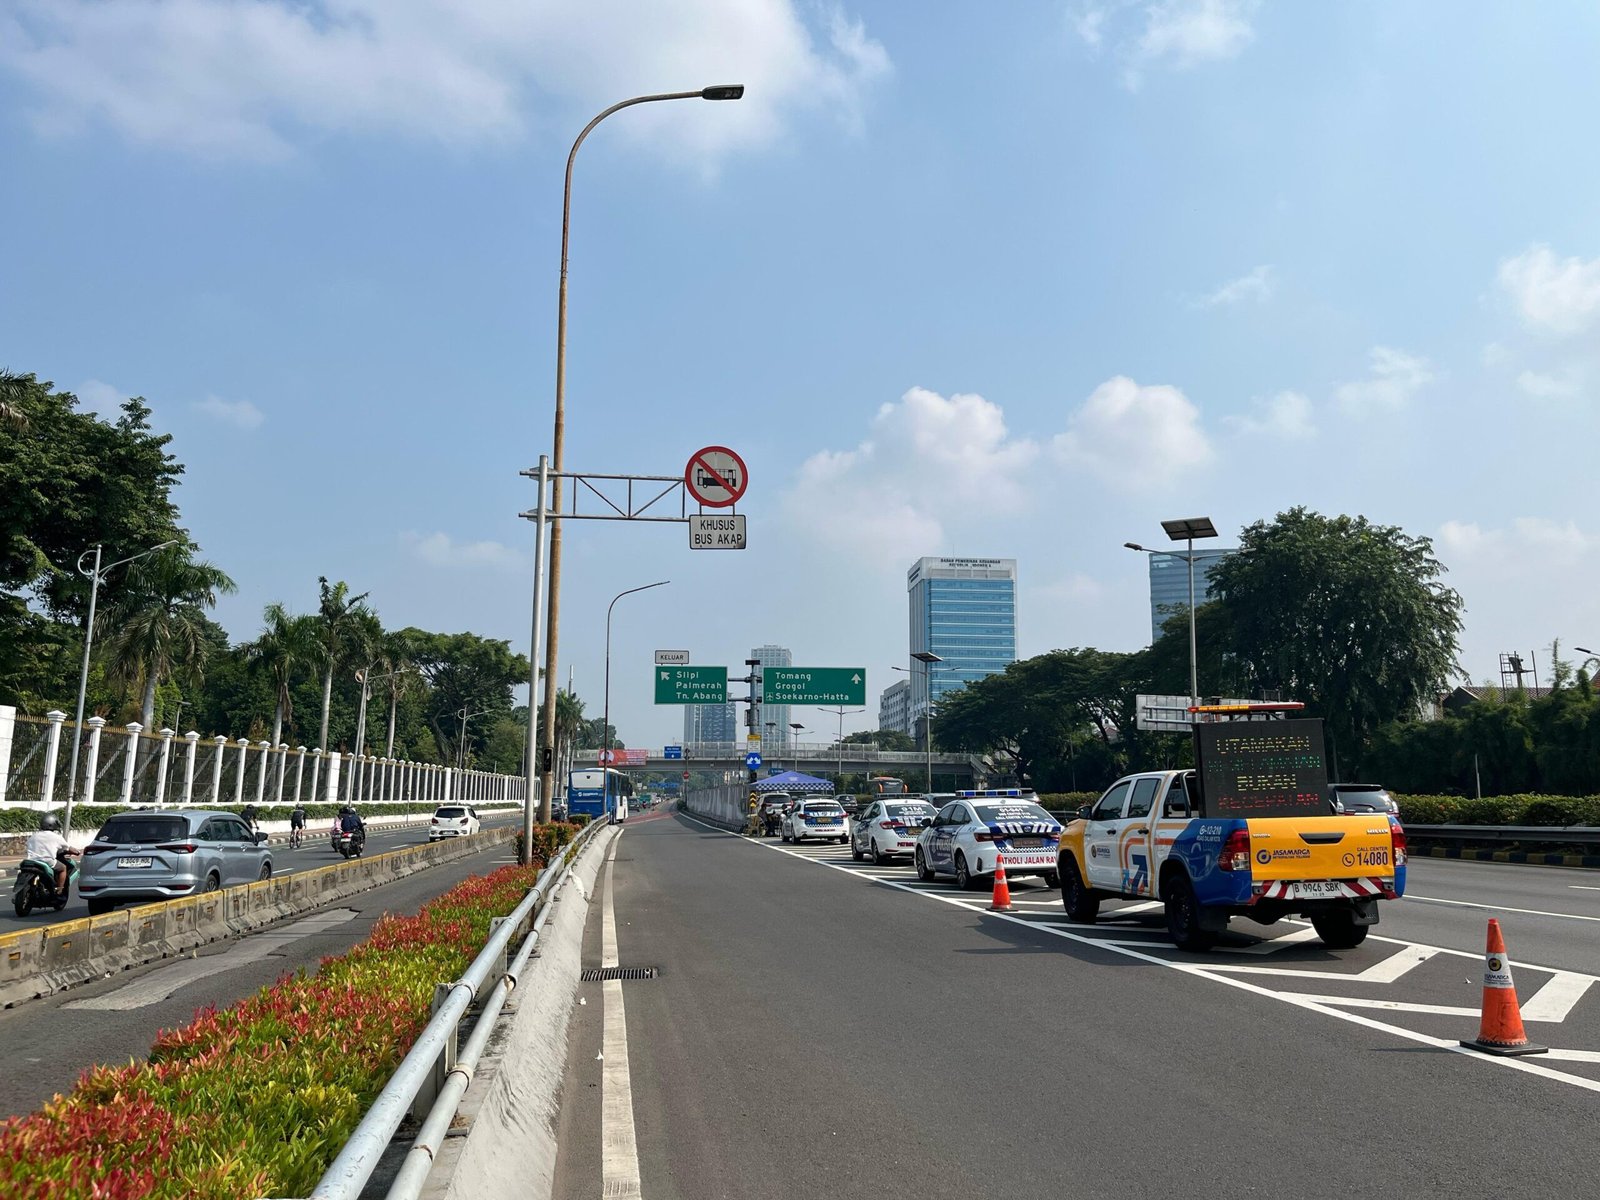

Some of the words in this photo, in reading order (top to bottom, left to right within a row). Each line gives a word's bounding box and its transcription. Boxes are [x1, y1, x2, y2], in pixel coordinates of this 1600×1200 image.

[700, 519, 735, 530] KHUSUS
[694, 533, 712, 545] BUS
[717, 533, 742, 545] AKAP
[676, 671, 699, 679] Slipi
[775, 672, 811, 681] Tomang
[775, 683, 806, 691] Grogol
[694, 692, 723, 700] Abang
[775, 692, 849, 700] Soekarno-Hatta
[1216, 736, 1310, 754] UTAMAKAN
[1236, 774, 1298, 792] BUKAN
[1001, 856, 1022, 865] ATROLI
[1024, 856, 1044, 864] JALAN
[1357, 851, 1388, 866] 14080
[1294, 884, 1300, 892] B
[1325, 882, 1341, 892] SBK
